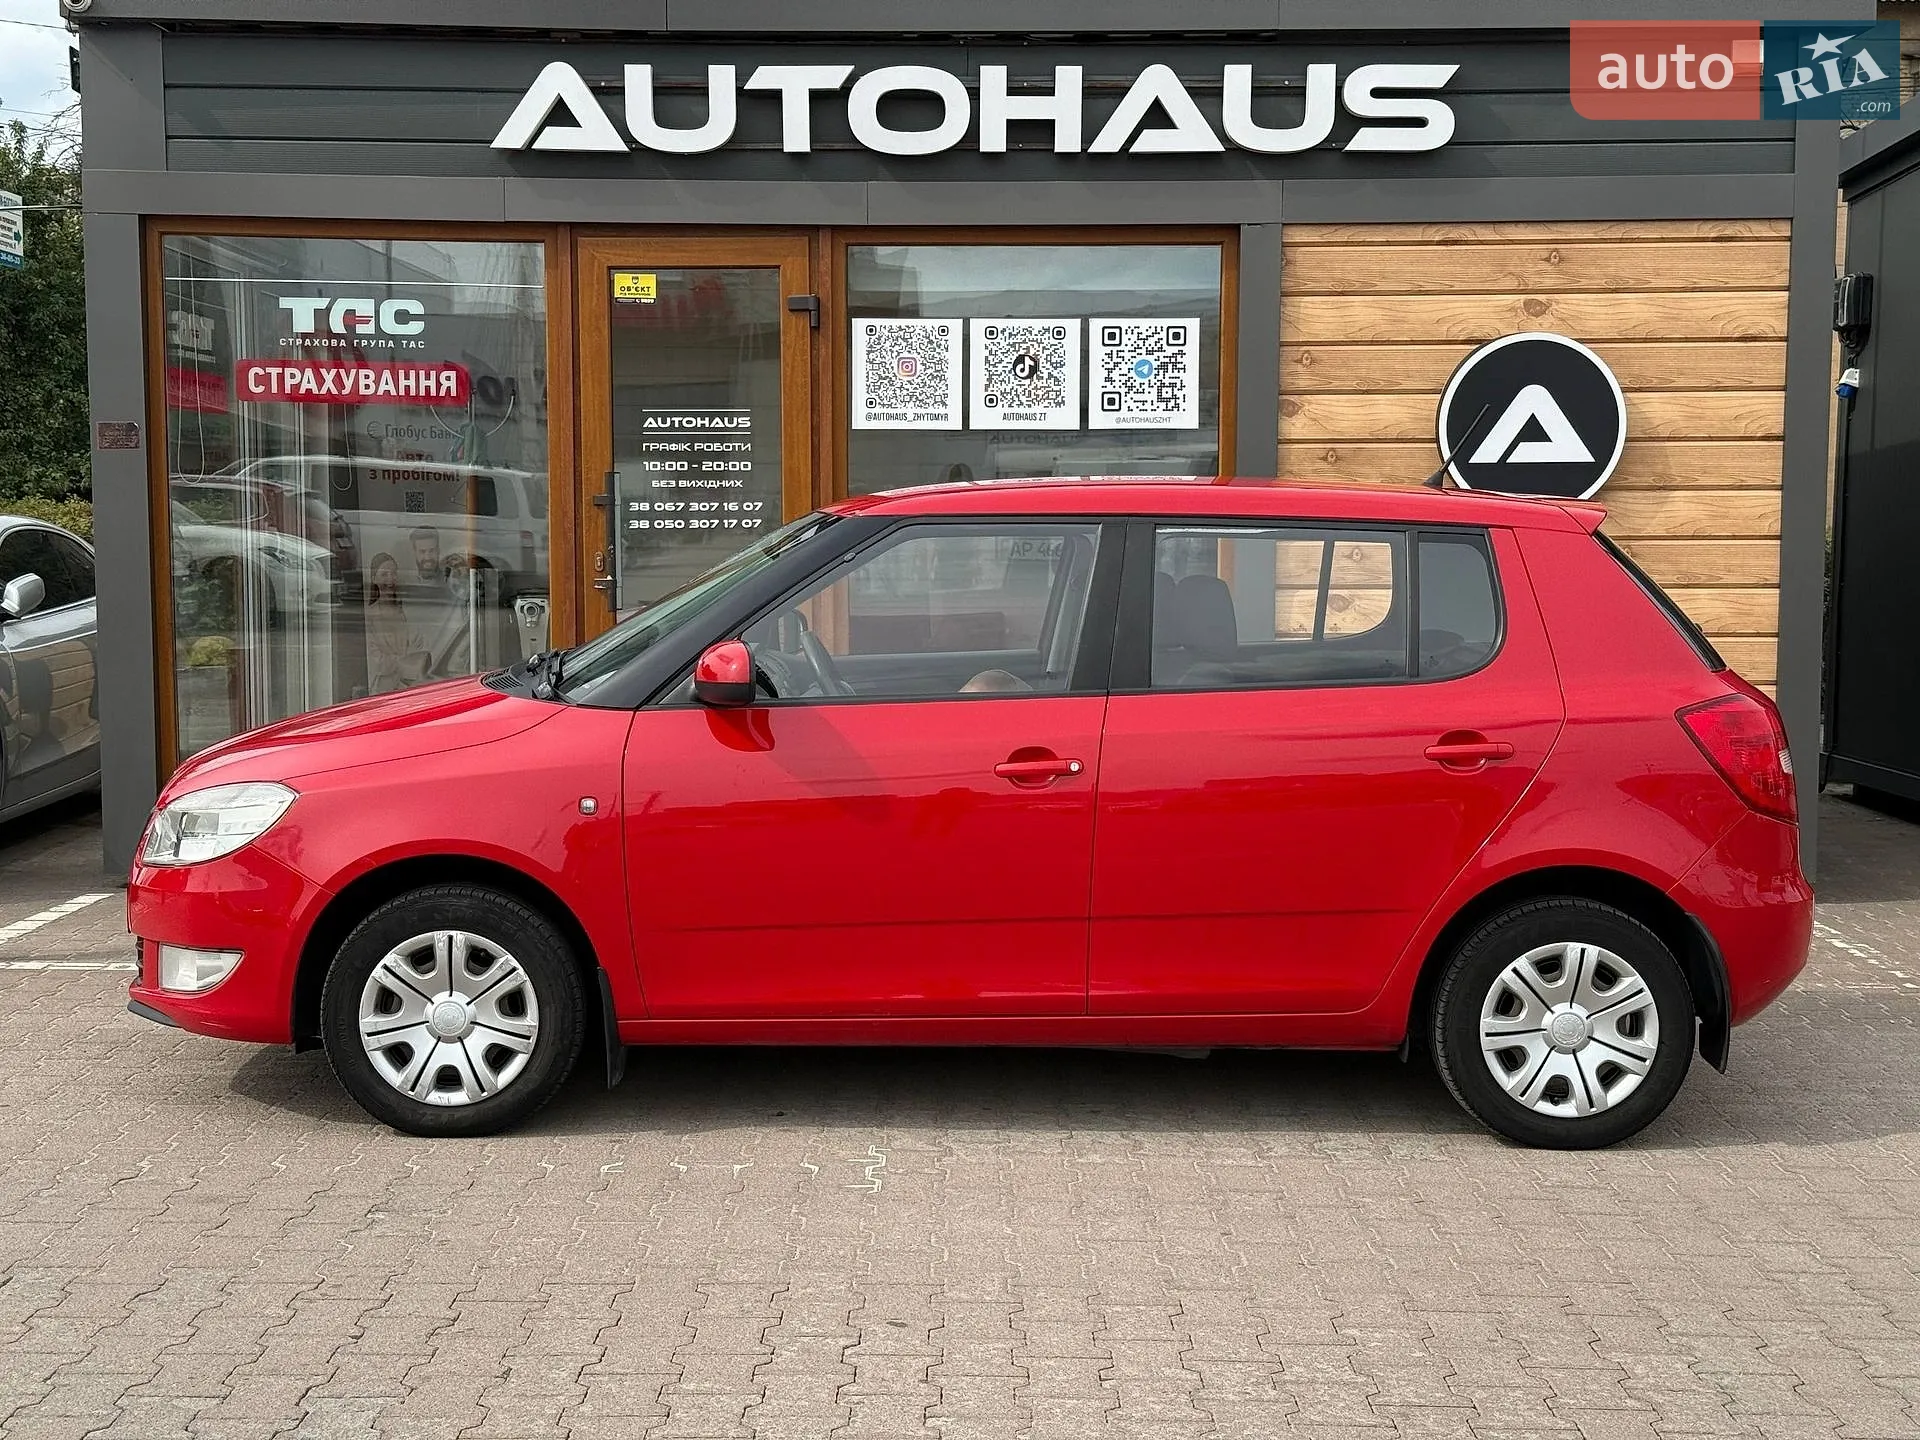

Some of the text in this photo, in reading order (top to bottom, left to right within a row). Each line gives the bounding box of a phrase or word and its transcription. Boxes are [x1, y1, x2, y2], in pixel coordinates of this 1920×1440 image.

[489, 61, 1461, 156] AUTOHAUS
[279, 338, 425, 349] СТРАХОВА ГРУПА ТАС
[247, 366, 458, 398] СТРАХУВАННЯ
[865, 412, 949, 423] @AUTOHAUS_ZHYTOMYR
[1002, 412, 1047, 421] AUTOHAUS ZT
[642, 416, 752, 428] AUTOHAUS
[385, 424, 429, 441] Глобус
[642, 442, 752, 452] ГРАФІК РОБОТИ
[642, 461, 689, 471] 10:00
[702, 461, 752, 471] 20:00
[651, 480, 744, 489] БЕЗ ВИХІДНИХ
[628, 502, 763, 511] 38 067 307 16 07
[628, 519, 762, 529] 38 050 307 17 07
